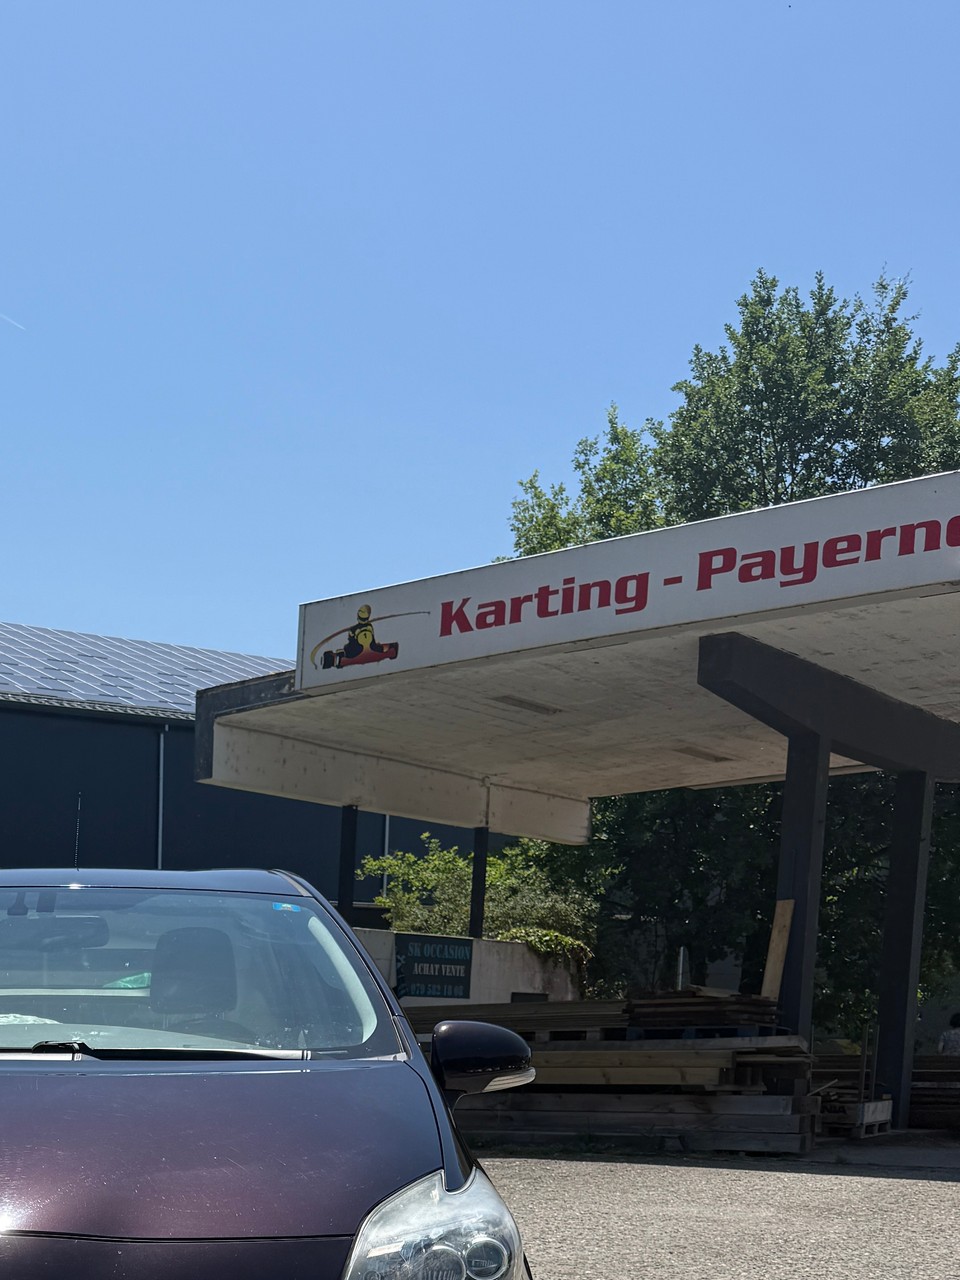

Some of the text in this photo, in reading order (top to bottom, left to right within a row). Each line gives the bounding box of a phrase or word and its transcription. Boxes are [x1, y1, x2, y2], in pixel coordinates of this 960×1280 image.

[439, 572, 650, 637] Karting
[408, 942, 471, 960] SK OCCASION
[413, 962, 466, 977] ACHAT VENTE
